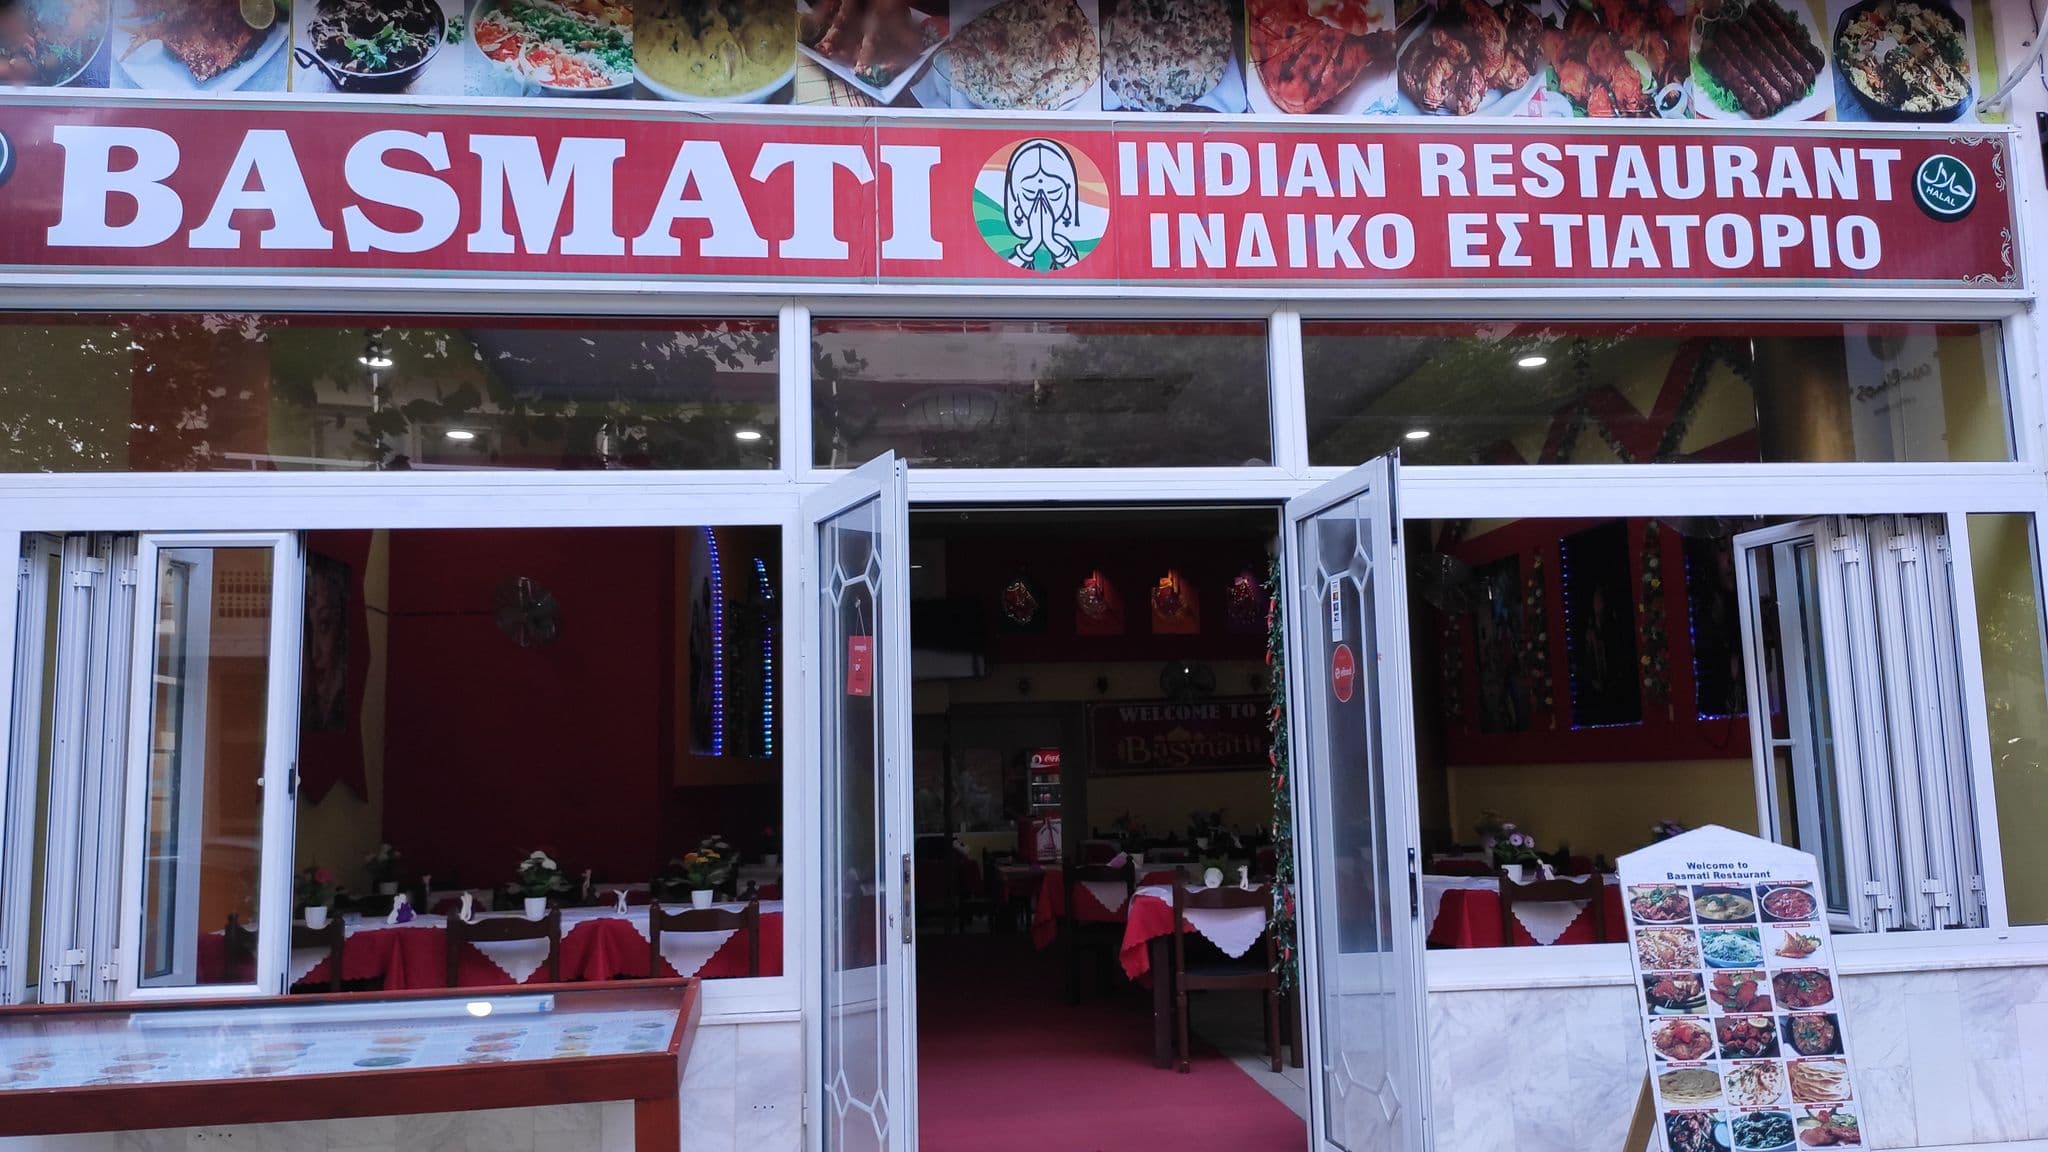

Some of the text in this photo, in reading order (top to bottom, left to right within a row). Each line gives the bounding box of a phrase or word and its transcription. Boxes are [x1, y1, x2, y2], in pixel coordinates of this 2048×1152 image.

[1118, 142, 1902, 201] INDIAN RESTAURANT
[47, 125, 942, 260] BASMATI
[1926, 186, 1956, 207] HALAL
[1150, 212, 1882, 271] ΙΝΔΙΚΟ ΕΣΤΙΑΤΟΡΙΟ
[1119, 703, 1257, 722] WELCOME TO
[1666, 870, 1771, 880] Basmati Restaurant
[1686, 861, 1749, 870] Welcome to
